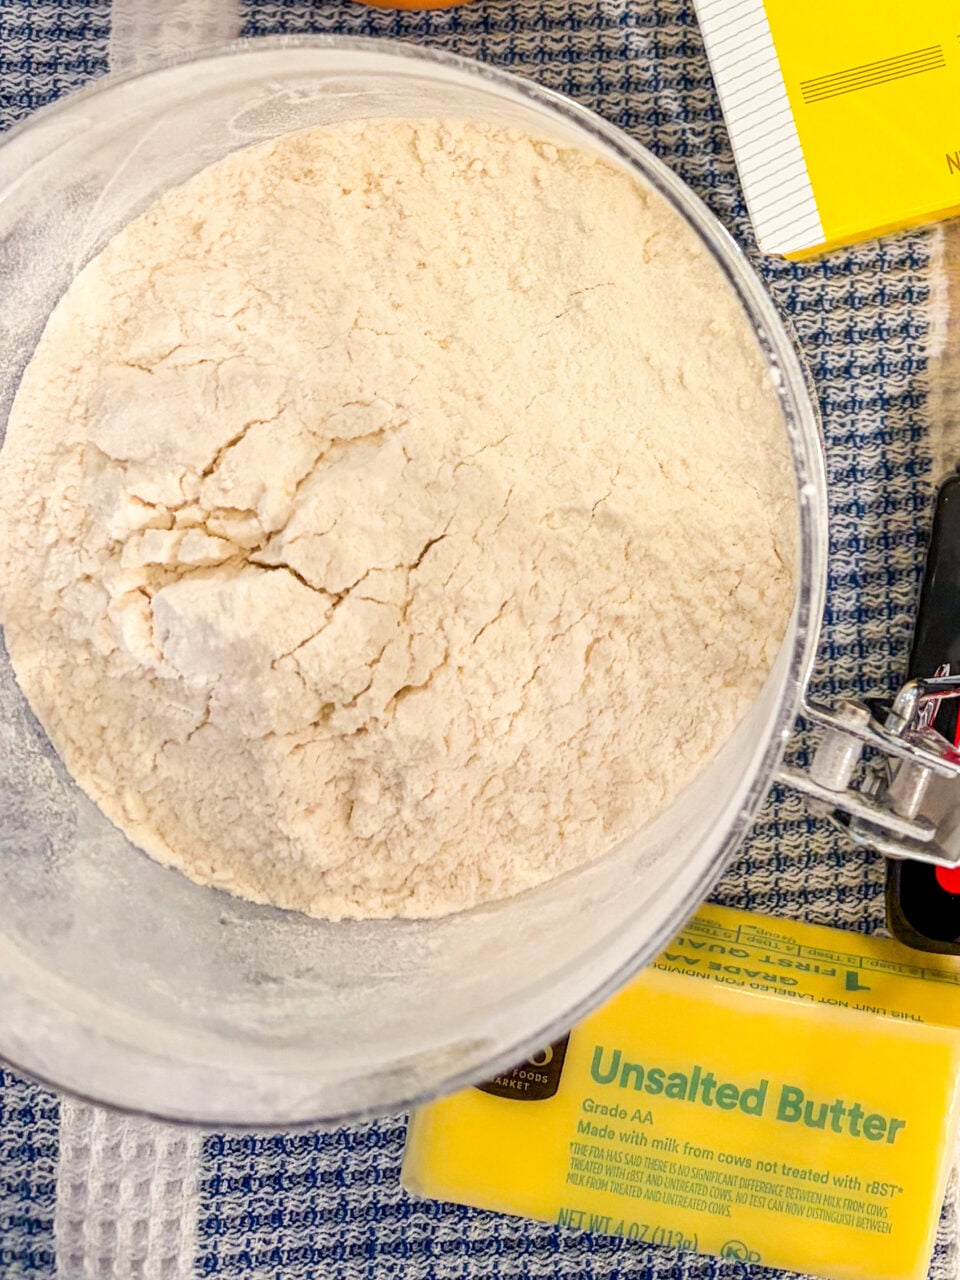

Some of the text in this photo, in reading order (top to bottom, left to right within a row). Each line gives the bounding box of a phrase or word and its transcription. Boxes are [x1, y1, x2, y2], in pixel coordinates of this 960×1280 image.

[663, 952, 799, 987] GRADE AA
[677, 938, 836, 977] FIRST QUAL
[582, 1099, 653, 1125] Grade AA
[590, 1045, 905, 1145] Unsalted Butter
[577, 1120, 615, 1139] Made
[620, 1131, 647, 1147] with
[652, 1138, 680, 1153] milk
[683, 1142, 713, 1160] from
[717, 1153, 752, 1169] cows
[756, 1160, 778, 1174] not
[782, 1164, 830, 1184] treated
[833, 1172, 861, 1191] with
